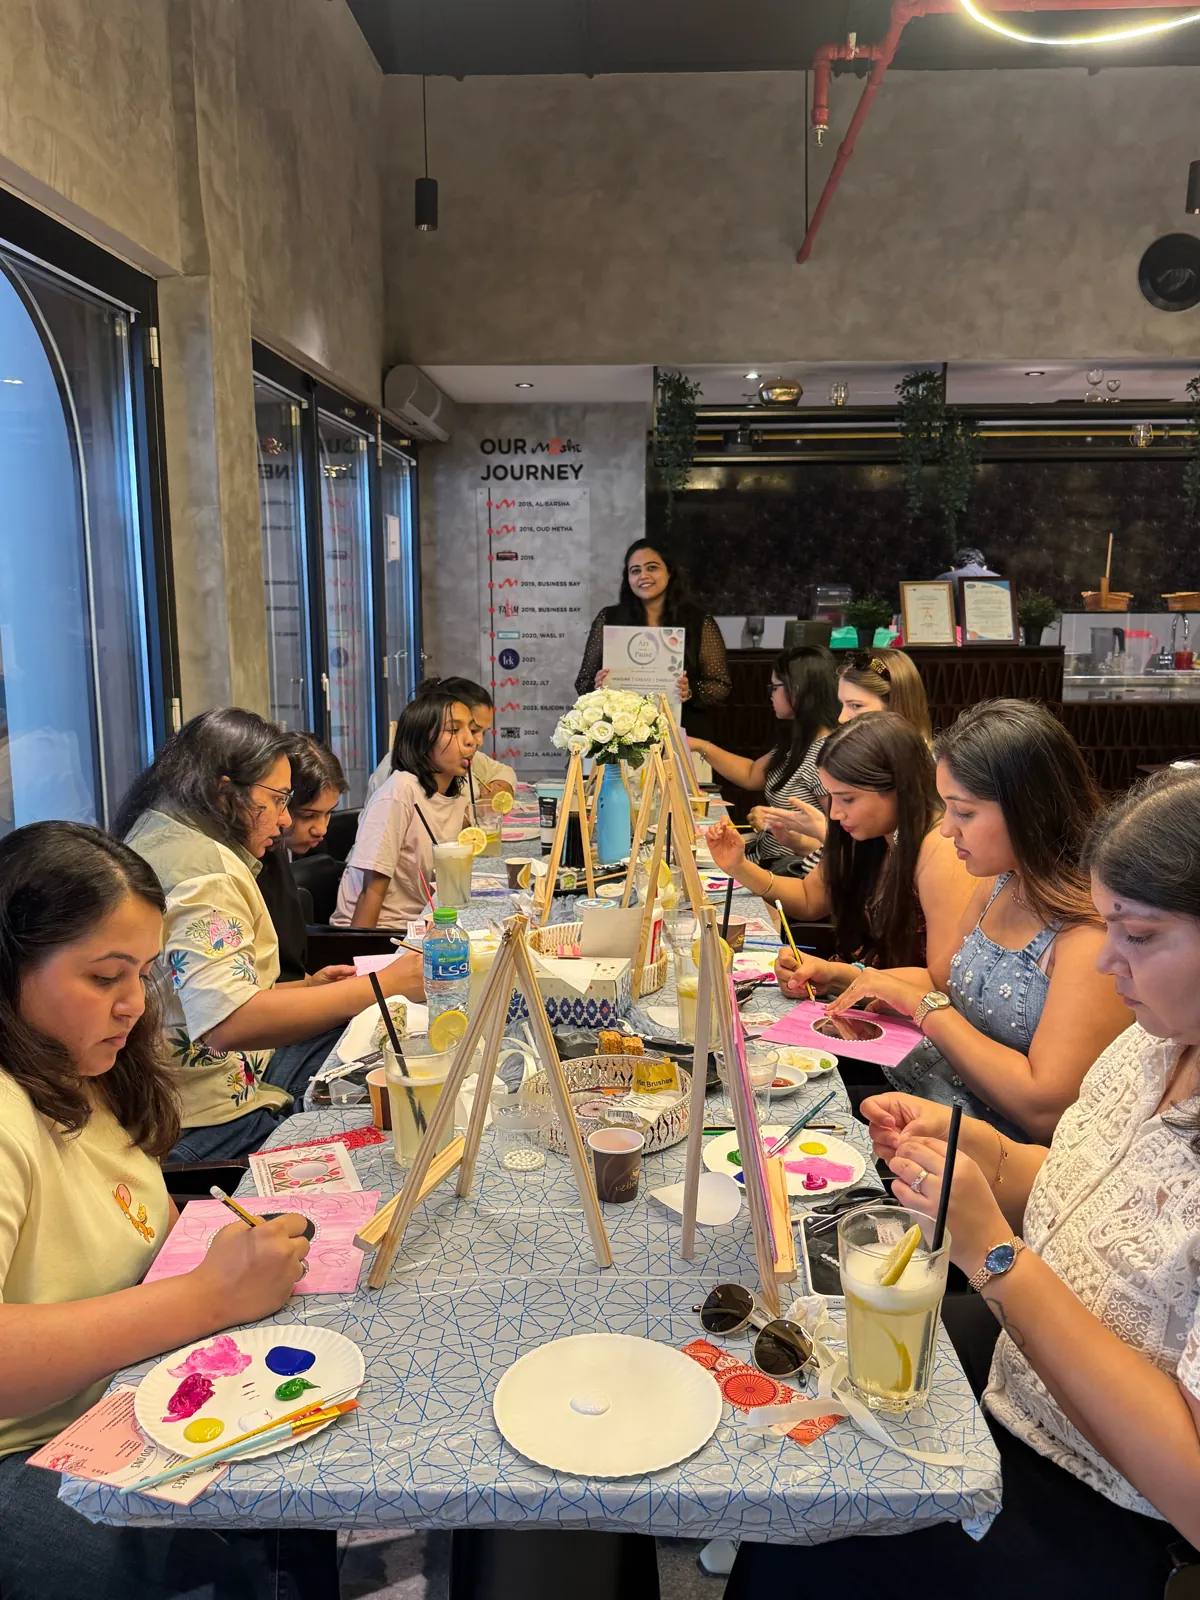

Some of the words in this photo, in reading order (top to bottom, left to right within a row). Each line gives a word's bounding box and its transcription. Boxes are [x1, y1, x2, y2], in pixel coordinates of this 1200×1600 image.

[480, 438, 527, 455] OUR
[480, 463, 584, 481] JOURNEY
[646, 1077, 673, 1088] Brushes
